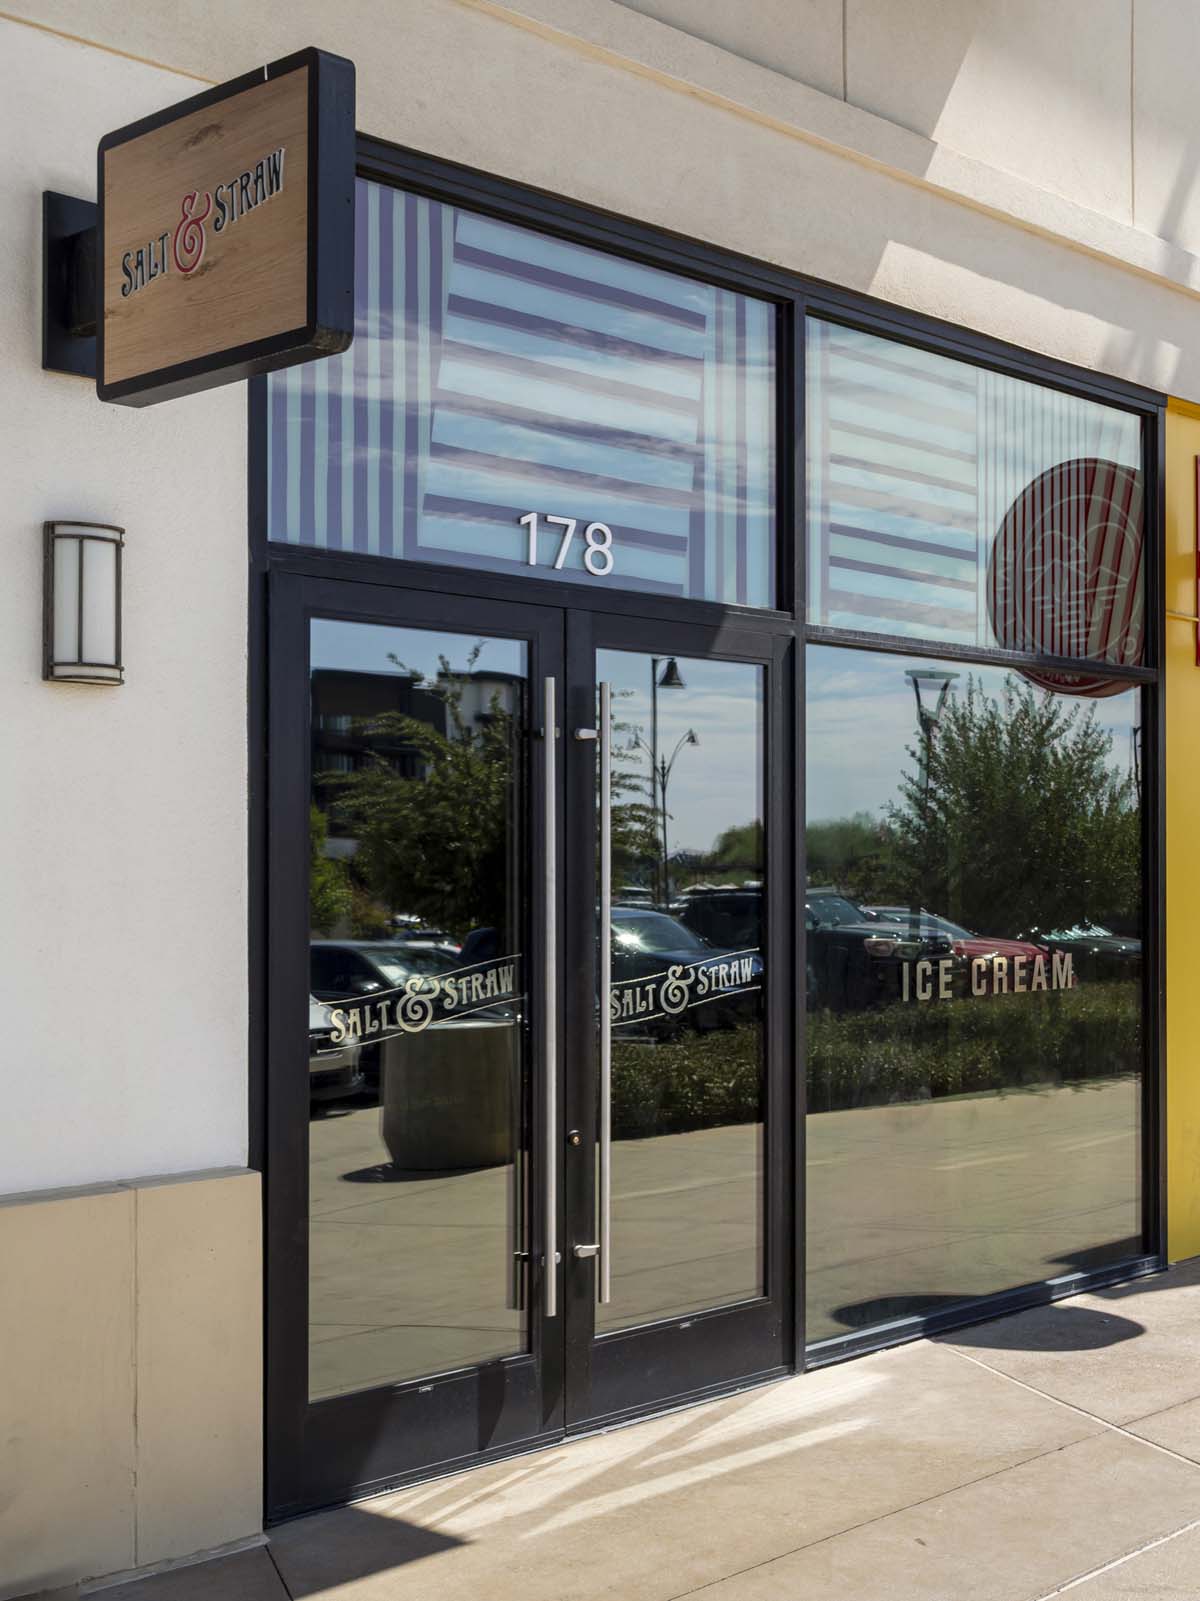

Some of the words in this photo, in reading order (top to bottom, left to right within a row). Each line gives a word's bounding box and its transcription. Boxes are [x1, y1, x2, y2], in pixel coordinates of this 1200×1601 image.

[120, 233, 169, 297] SALT
[173, 191, 212, 274] &
[214, 148, 285, 232] STRAW
[520, 512, 614, 575] 178
[330, 998, 391, 1044] SALT
[397, 978, 440, 1033] &
[444, 964, 515, 1010] STRAW
[609, 983, 656, 1020] SALT
[660, 964, 695, 1015] &
[697, 957, 753, 995] STRAW
[903, 959, 953, 1001] ICE
[971, 953, 1073, 997] CREAM
